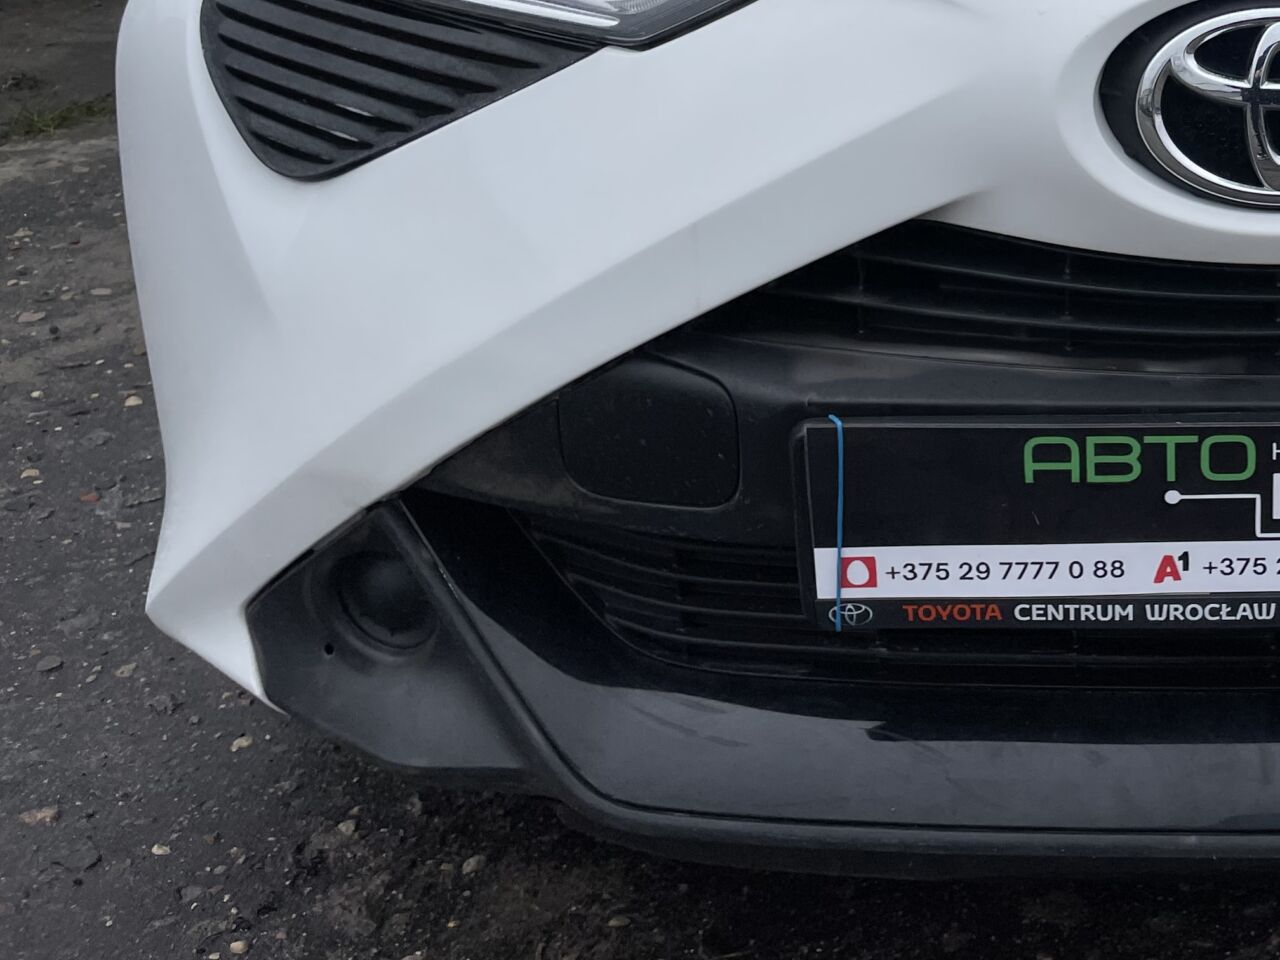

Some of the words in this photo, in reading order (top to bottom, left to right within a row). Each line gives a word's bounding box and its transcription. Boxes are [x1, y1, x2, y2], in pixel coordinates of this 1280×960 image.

[1023, 435, 1257, 484] АВТО
[885, 562, 950, 581] +375
[958, 562, 991, 581] 29
[999, 561, 1060, 580] 7777
[1068, 560, 1084, 580] 0
[1092, 560, 1126, 579] 88
[1203, 557, 1267, 577] +375
[902, 604, 1003, 622] TOYOTA
[1014, 603, 1134, 622] CENTRUM
[1145, 602, 1277, 621] WROCŁAW
